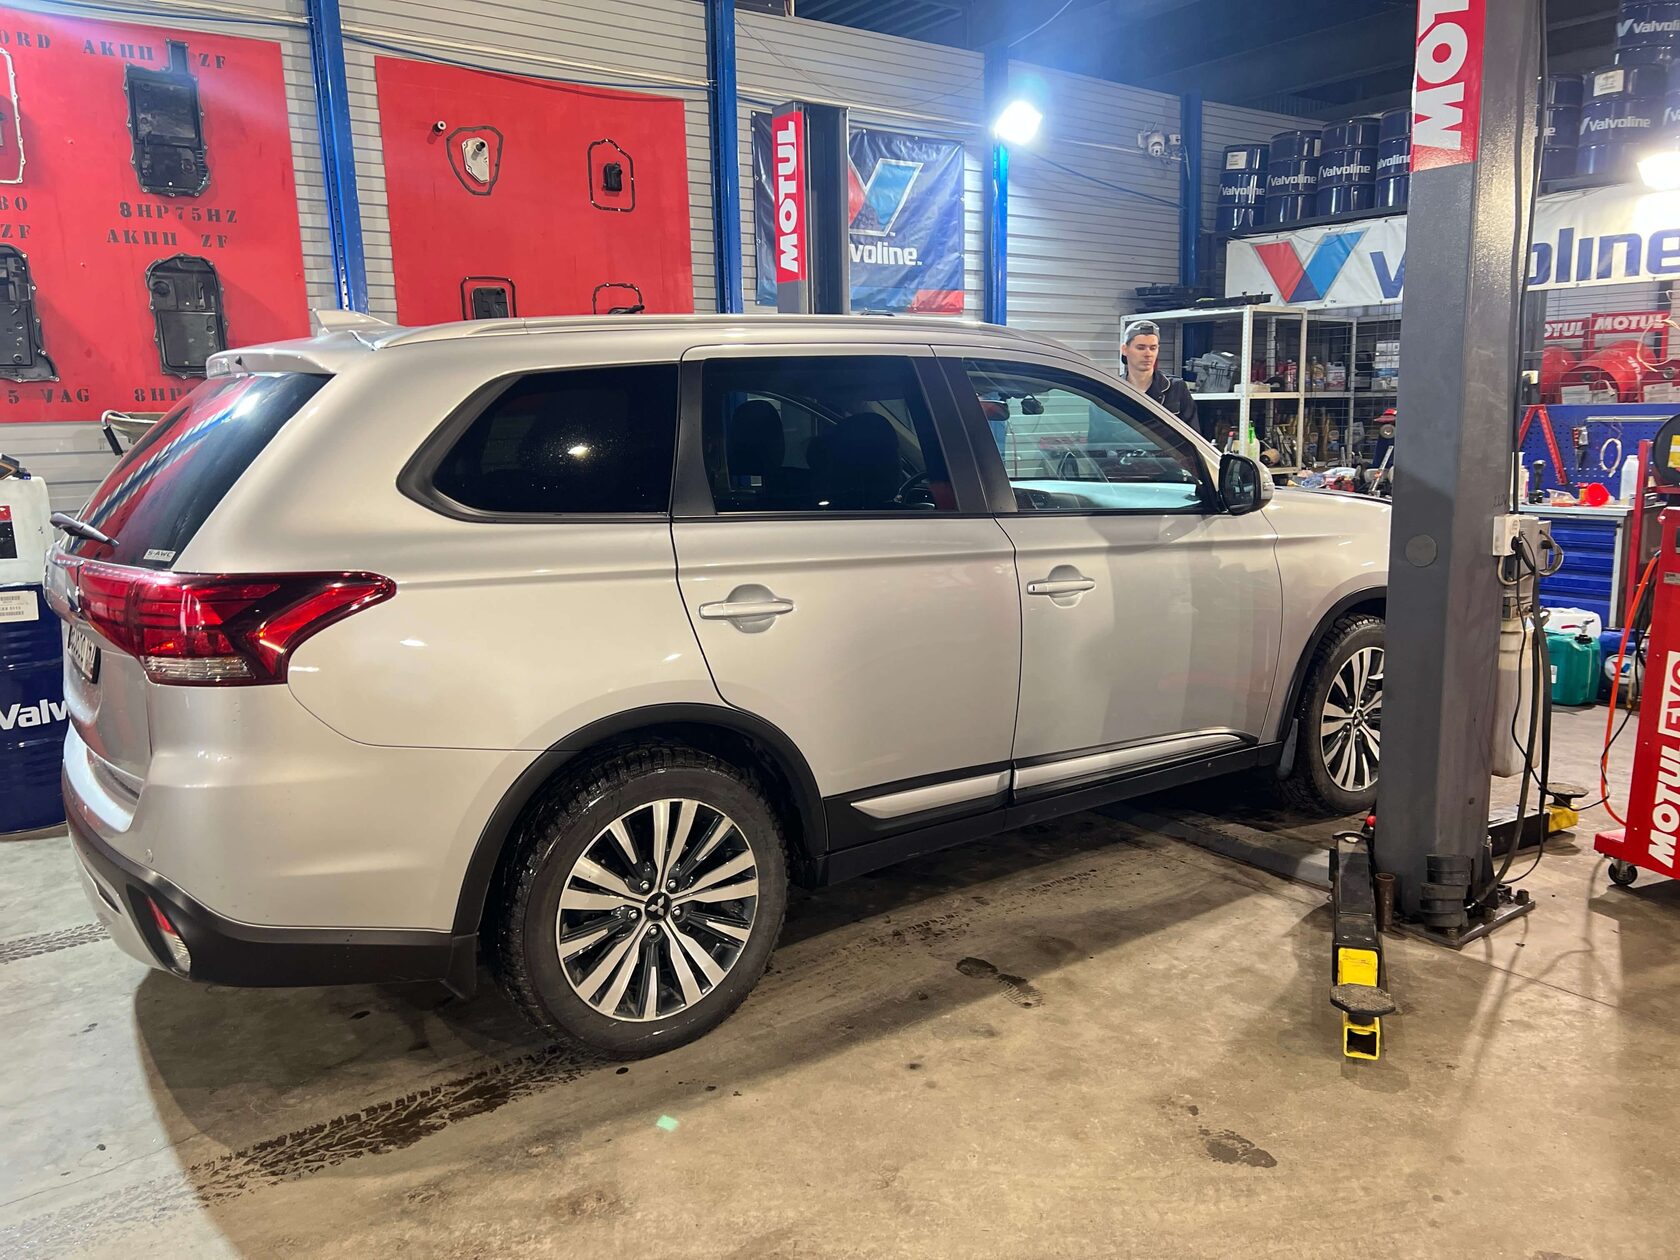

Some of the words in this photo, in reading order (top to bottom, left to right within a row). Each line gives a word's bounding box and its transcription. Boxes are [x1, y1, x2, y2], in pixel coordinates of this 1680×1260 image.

[1589, 116, 1651, 132] Valvoline
[1322, 164, 1371, 177] Valvoline
[1270, 175, 1317, 187] Valvoline
[777, 121, 798, 273] MOTUL
[1222, 186, 1265, 197] Valvoline
[201, 233, 229, 249] ZF
[1594, 315, 1665, 331] MOTUL
[41, 387, 90, 405] VAG
[134, 386, 192, 403] 8HP
